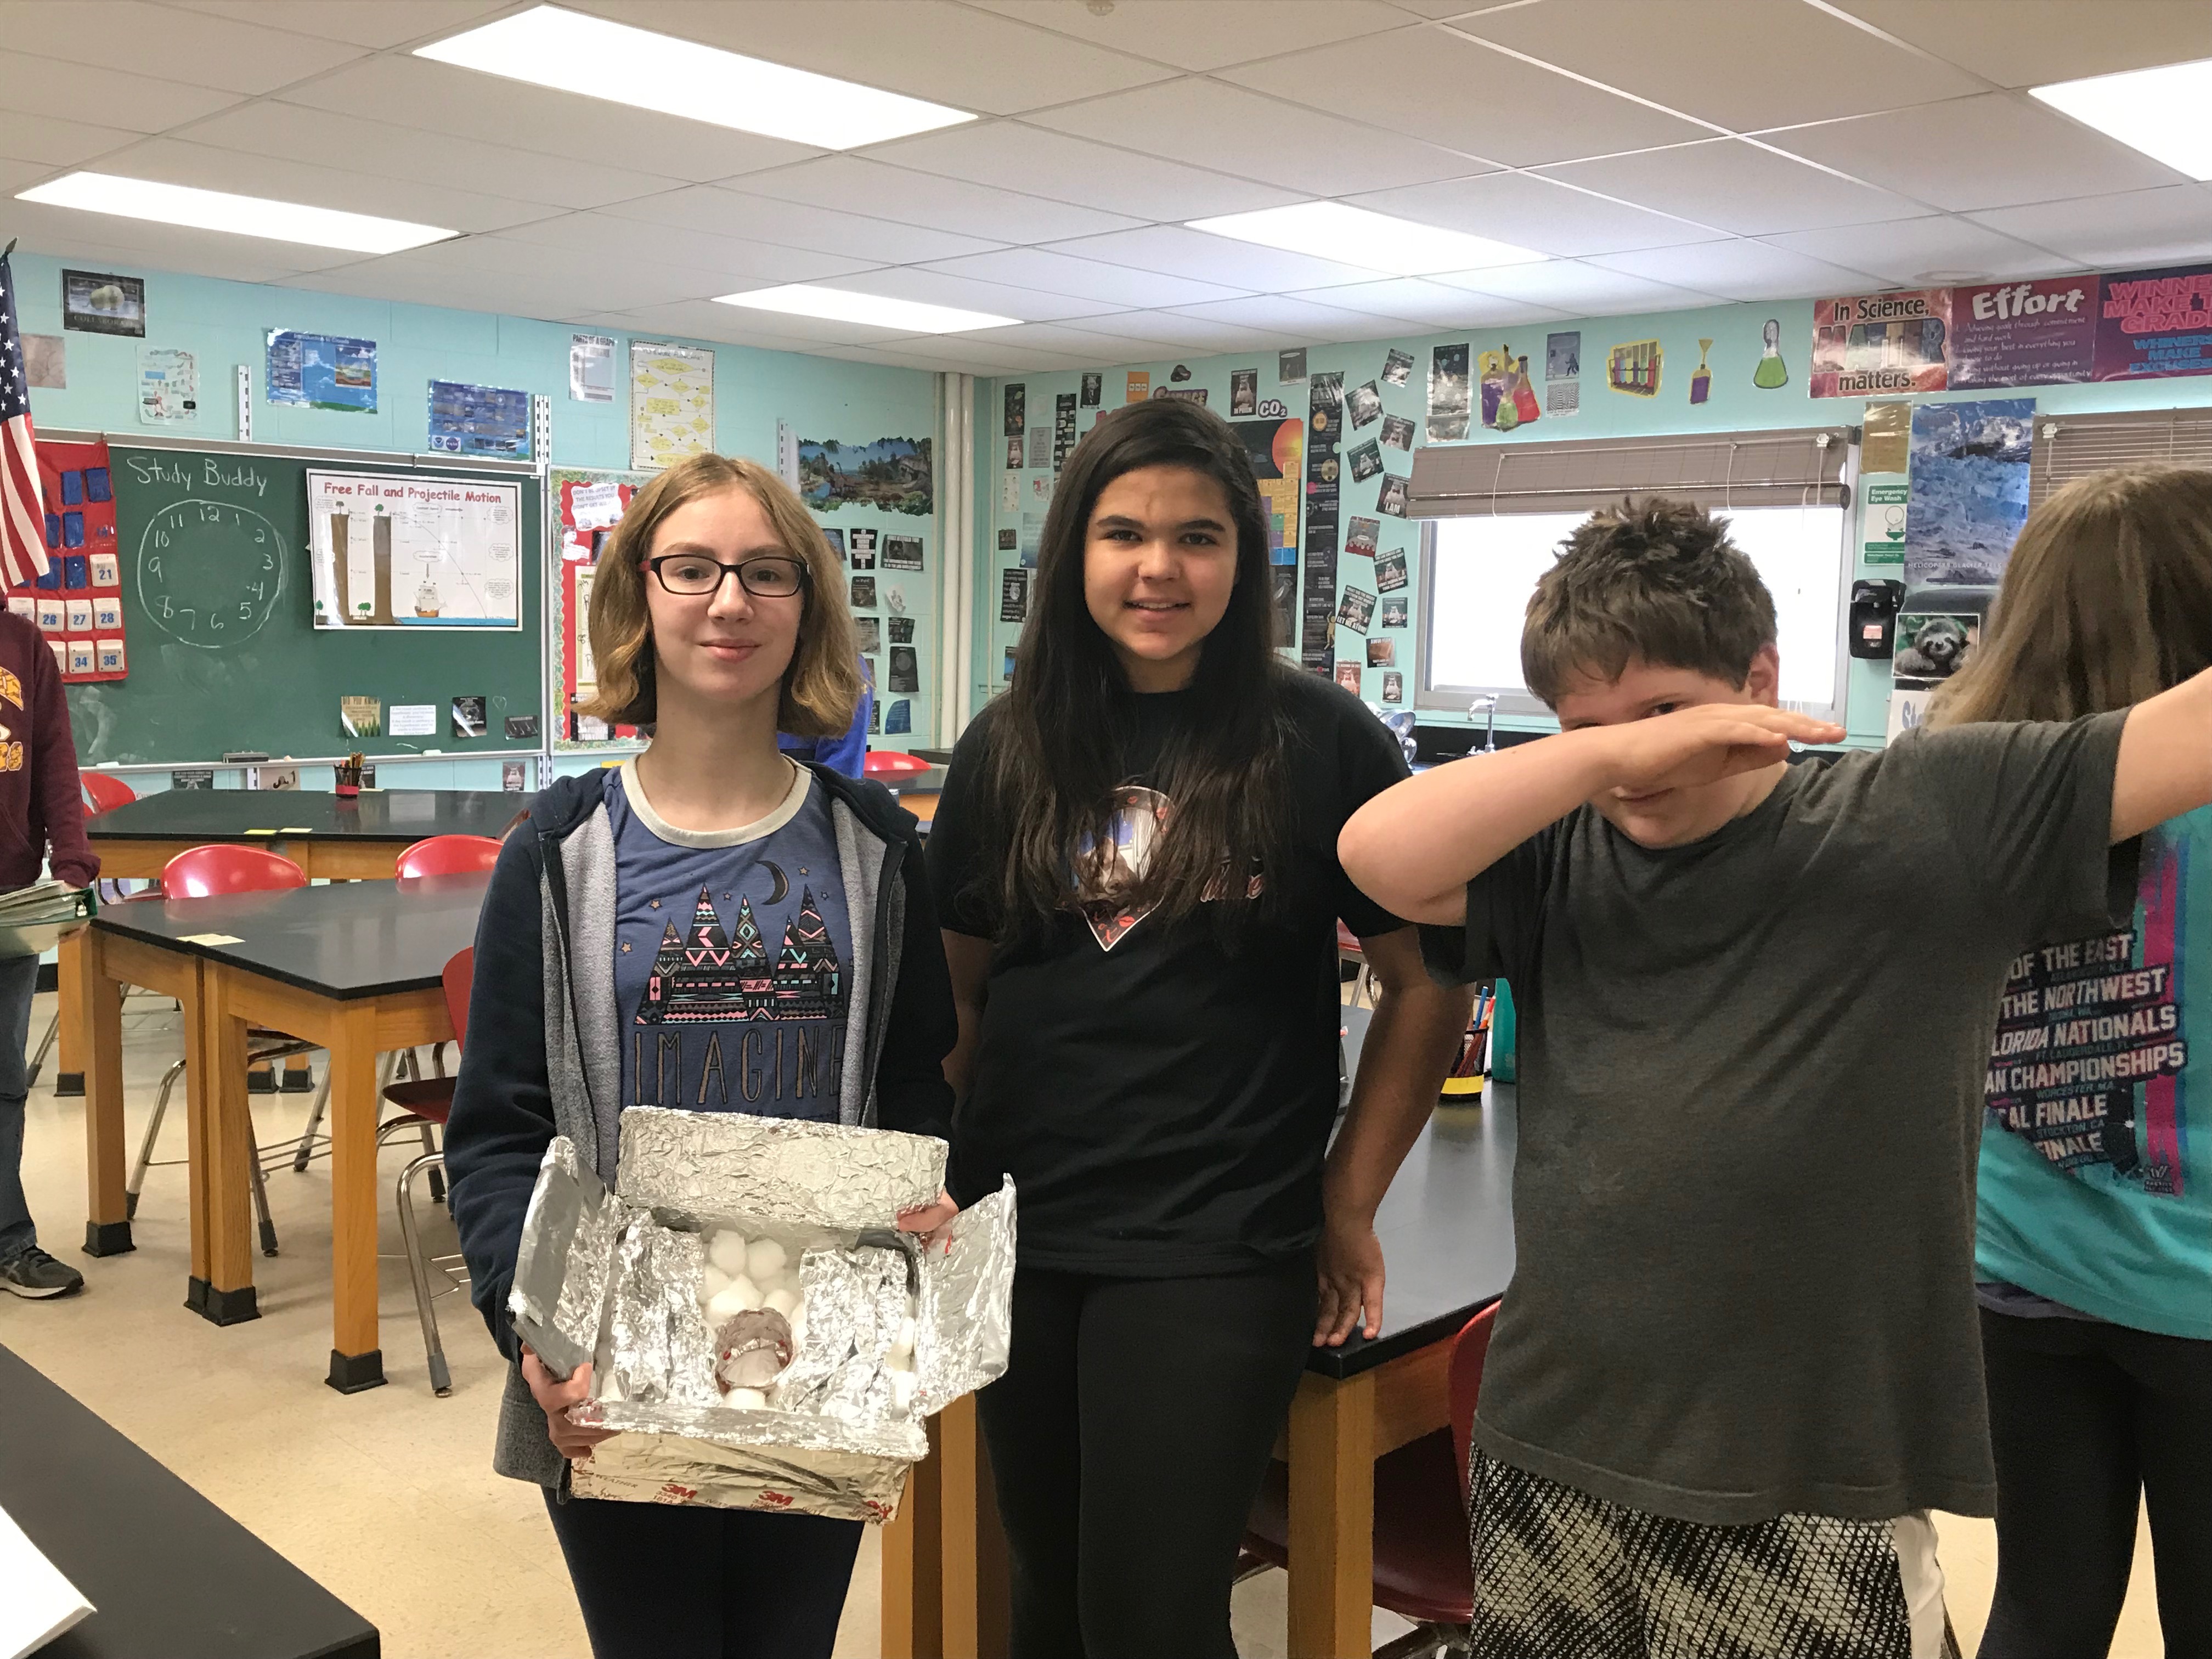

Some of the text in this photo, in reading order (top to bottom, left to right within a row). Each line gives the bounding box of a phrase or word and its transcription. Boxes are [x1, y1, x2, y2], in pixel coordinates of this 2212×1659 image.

[1834, 298, 1929, 321] In Science,
[1972, 284, 2084, 320] Effort
[2103, 294, 2193, 318] MAKE
[2014, 318, 2041, 329] through
[2044, 317, 2085, 326] commitment
[2120, 310, 2212, 334] GRAD
[1813, 318, 1946, 373] MATTER
[1964, 334, 1975, 343] and
[1978, 333, 1992, 343] hard
[2148, 346, 2201, 362] MAKE
[1839, 371, 1916, 391] matters.
[127, 456, 267, 496] Study Buddy
[324, 482, 501, 504] Free Fall and Projectile Motion
[170, 514, 183, 529] 11
[200, 506, 220, 522] 12
[235, 513, 240, 526] 1
[155, 529, 170, 548] 10
[254, 529, 265, 543] 2
[148, 556, 163, 583] 9
[262, 553, 274, 571] 3
[99, 569, 112, 580] 21
[251, 581, 264, 601] 4
[155, 595, 174, 619] 8
[239, 602, 252, 620] 5
[42, 614, 57, 625] 26
[73, 614, 86, 626] 27
[100, 612, 114, 624] 28
[179, 608, 196, 630] 7
[210, 613, 224, 629] 6
[75, 654, 117, 668] 34 35
[2010, 952, 2035, 980] OF
[2041, 942, 2081, 972] THE
[2084, 933, 2134, 964] EAST
[2002, 989, 2039, 1019] THE
[2044, 968, 2168, 1012] NORTHWEST
[1991, 1005, 2177, 1057] LORIDA NATIONALS
[635, 1024, 844, 1105] IMAGINE
[2011, 1041, 2186, 1092] CHAMPIONSHIPS
[2036, 1093, 2109, 1127] FINALE
[661, 1483, 698, 1499] 3M
[758, 1491, 794, 1506] 3M
